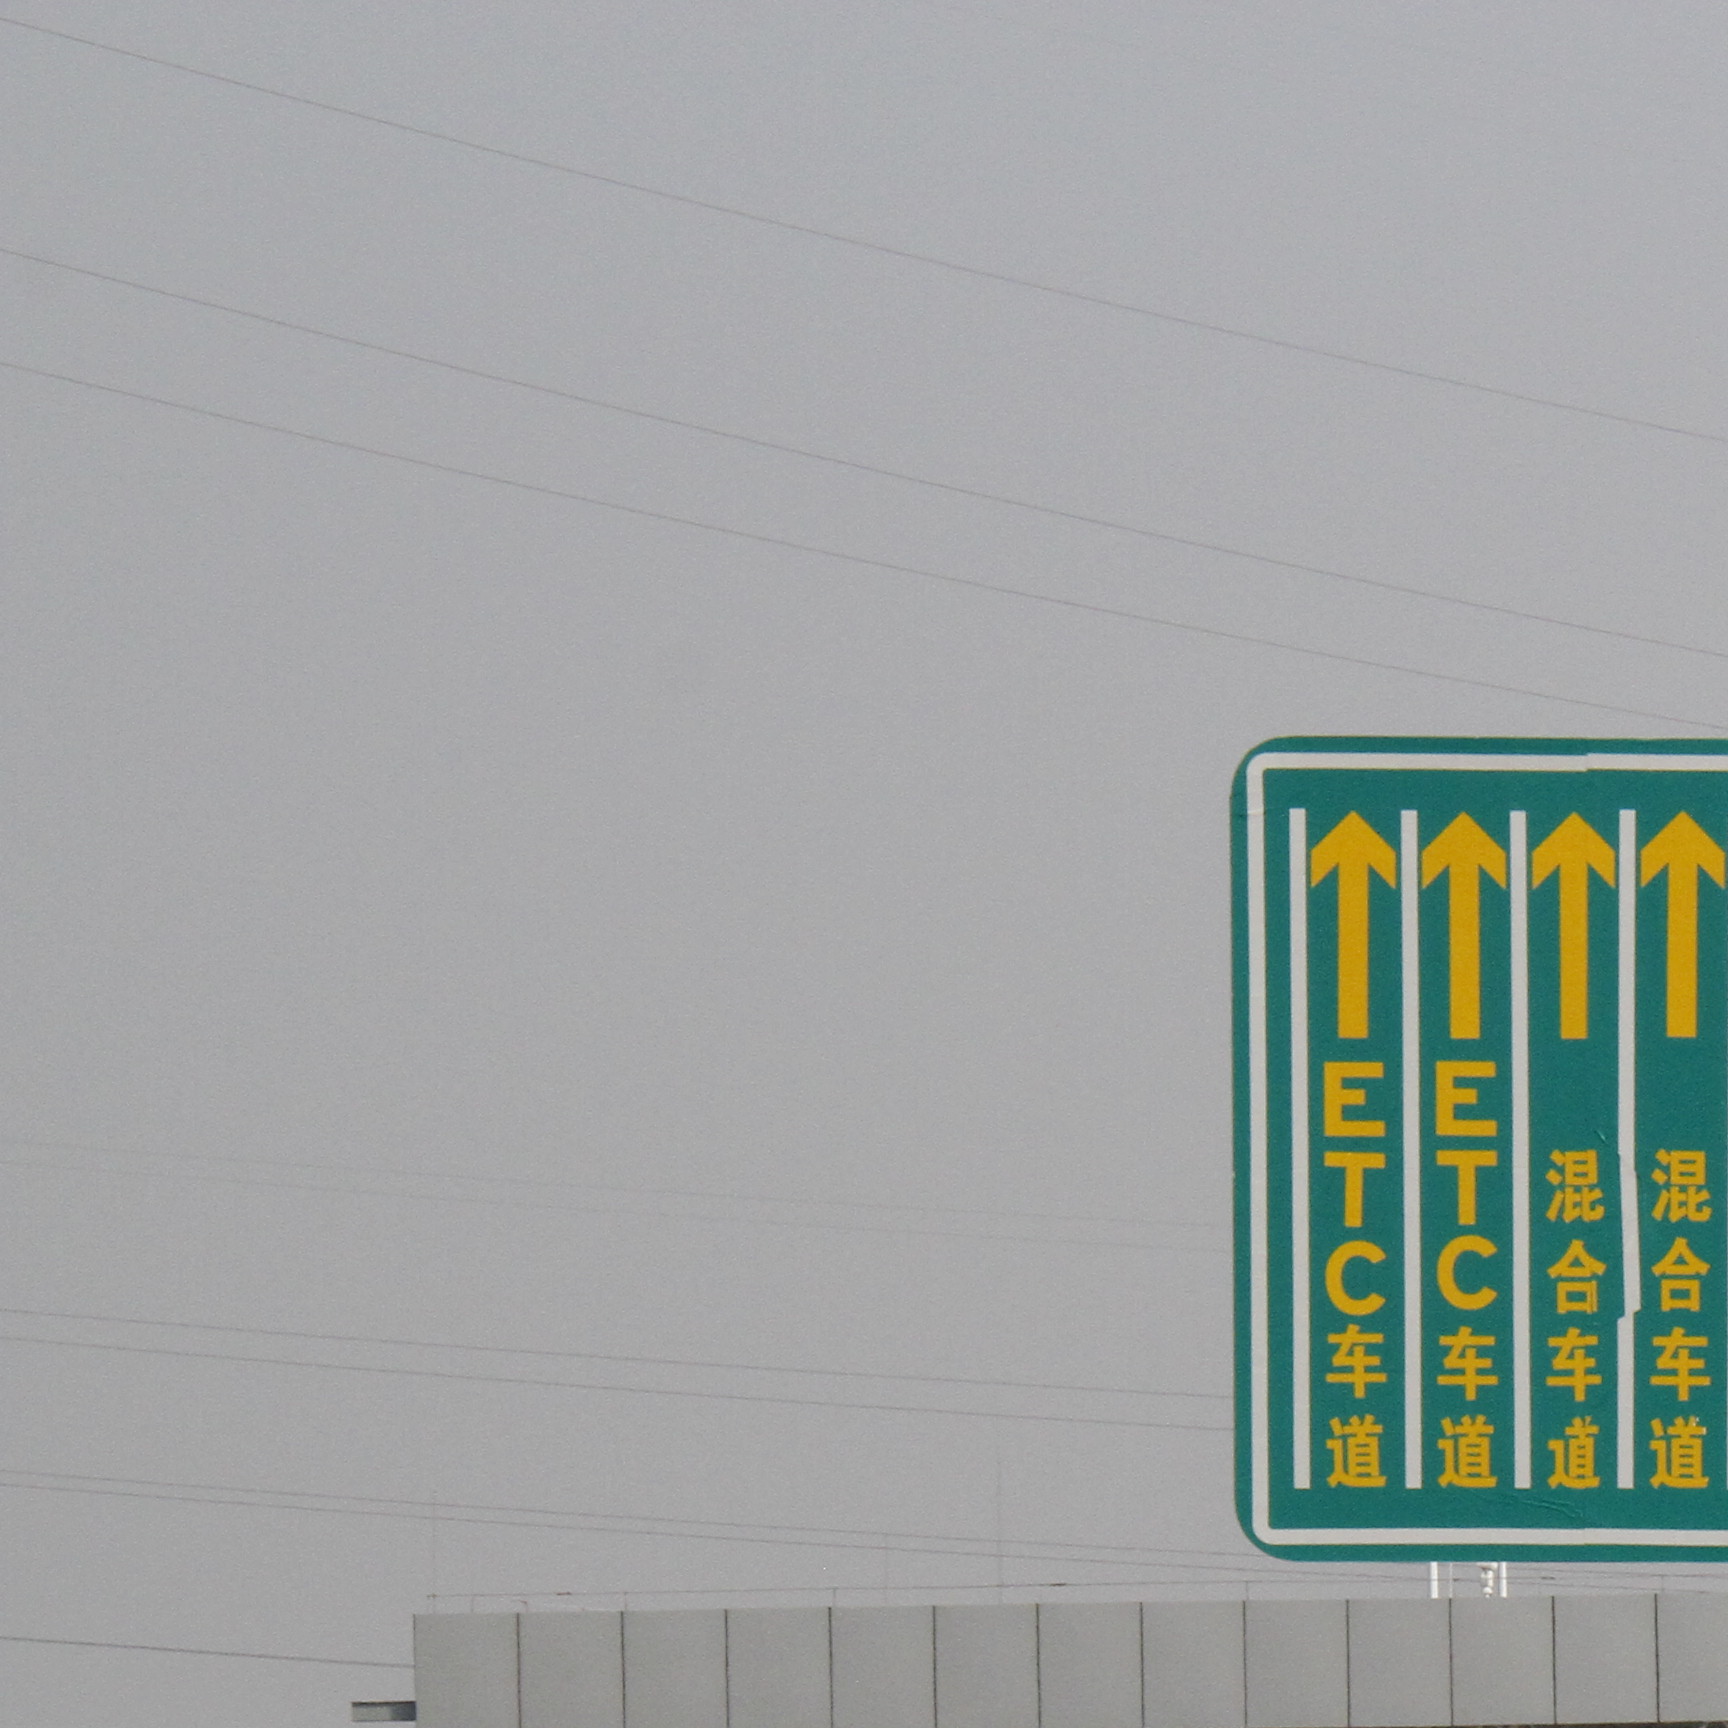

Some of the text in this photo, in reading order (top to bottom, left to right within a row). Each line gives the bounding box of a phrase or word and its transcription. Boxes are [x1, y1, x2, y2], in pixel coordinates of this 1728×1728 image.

[1546, 1149, 1606, 1490] 混合车道
[1650, 1149, 1711, 1490] 混合车道
